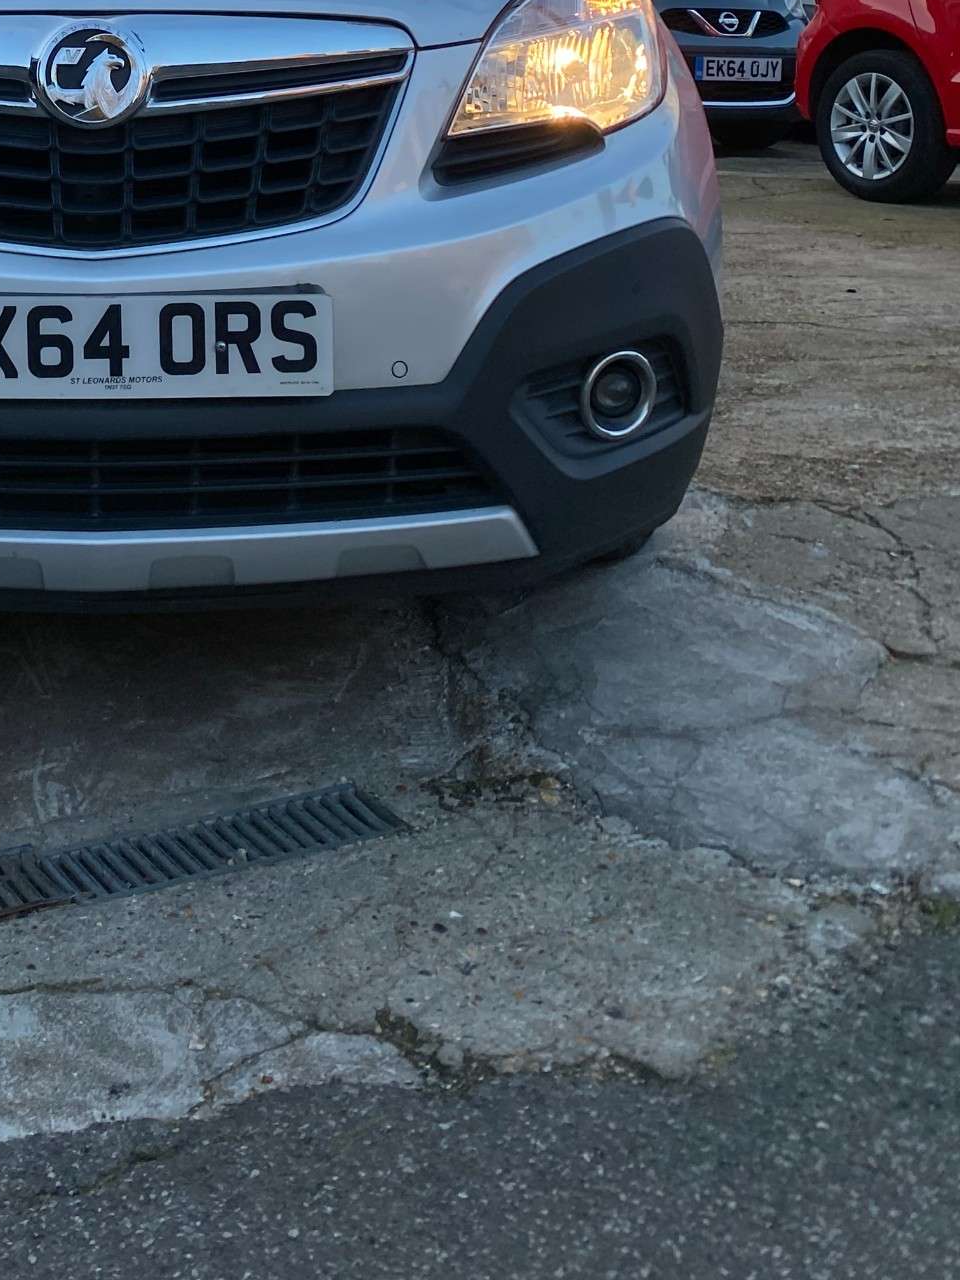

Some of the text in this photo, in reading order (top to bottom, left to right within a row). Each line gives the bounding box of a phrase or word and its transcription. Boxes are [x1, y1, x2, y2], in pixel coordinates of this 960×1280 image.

[706, 59, 746, 78] EK64
[82, 376, 127, 385] LEONARDS
[128, 375, 163, 384] MOTORS
